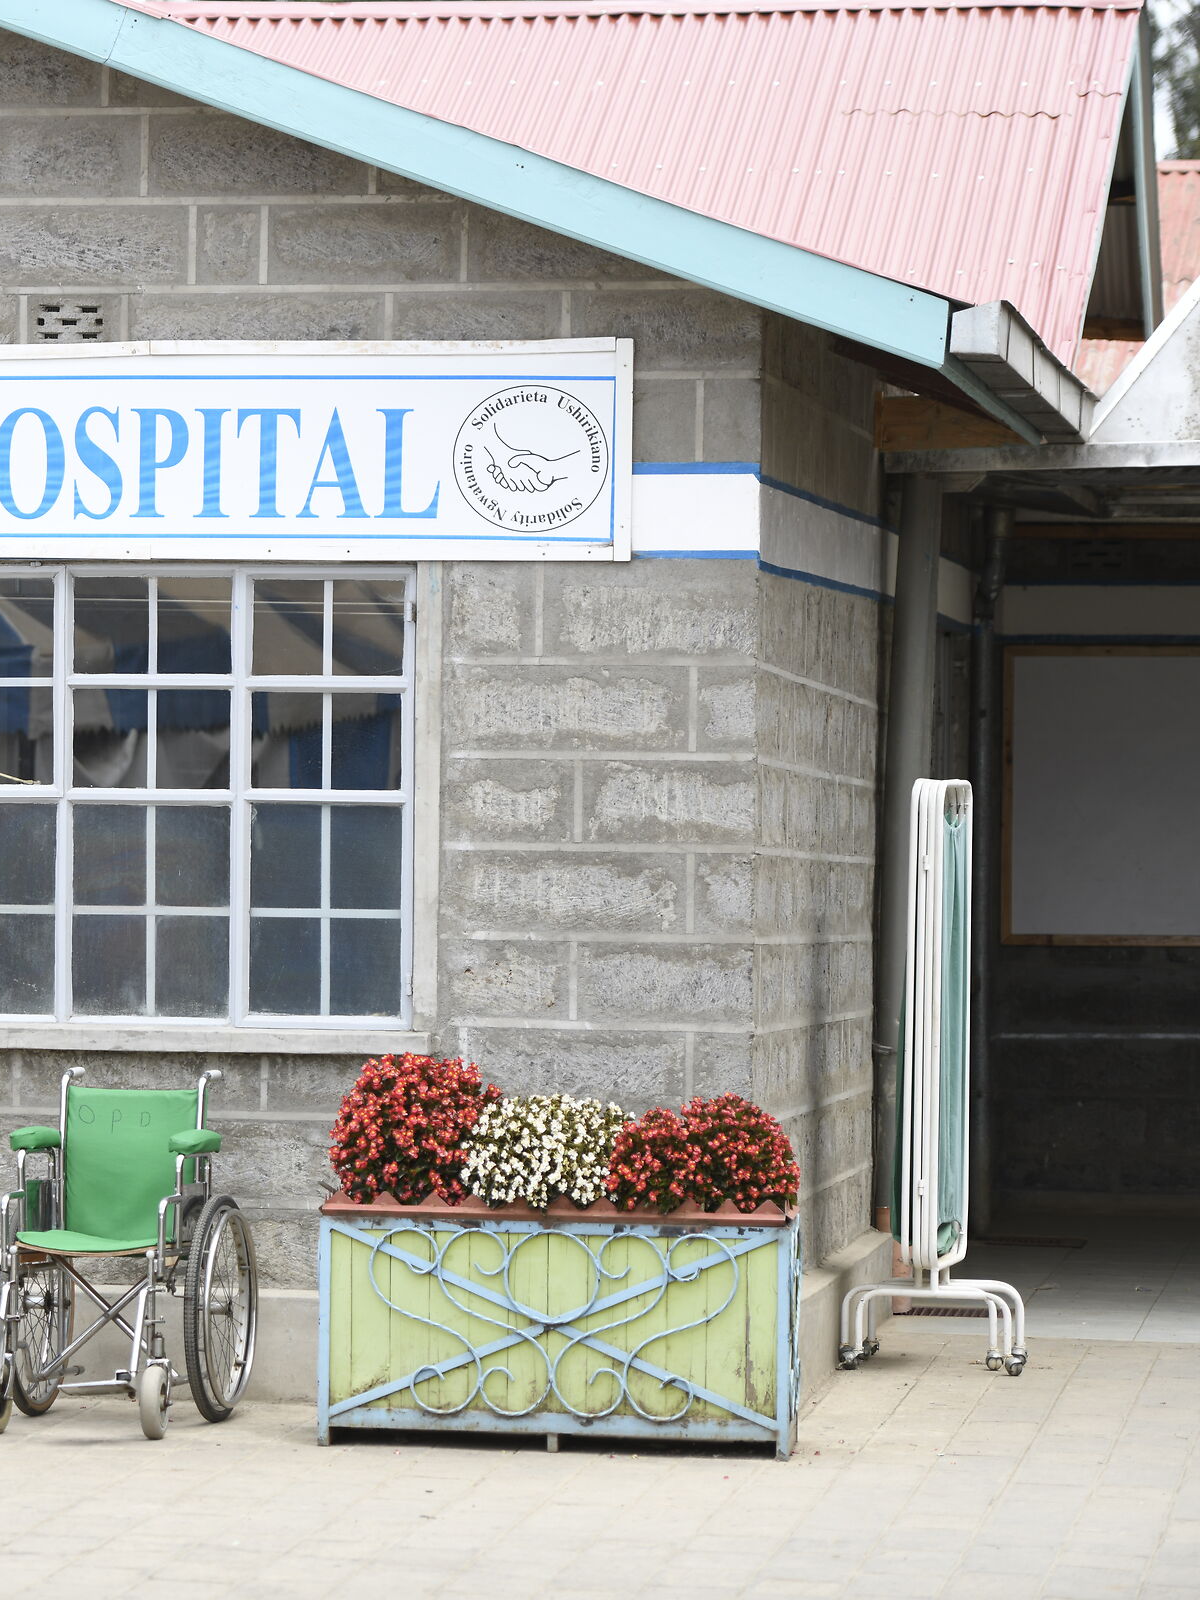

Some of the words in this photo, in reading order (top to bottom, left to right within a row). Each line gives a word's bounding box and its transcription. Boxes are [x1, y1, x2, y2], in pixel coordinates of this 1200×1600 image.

[471, 390, 548, 430] Solidarieta
[557, 395, 602, 473] Ushirikiano
[460, 444, 507, 521] Ngwataniro
[511, 497, 583, 527] Solidarity
